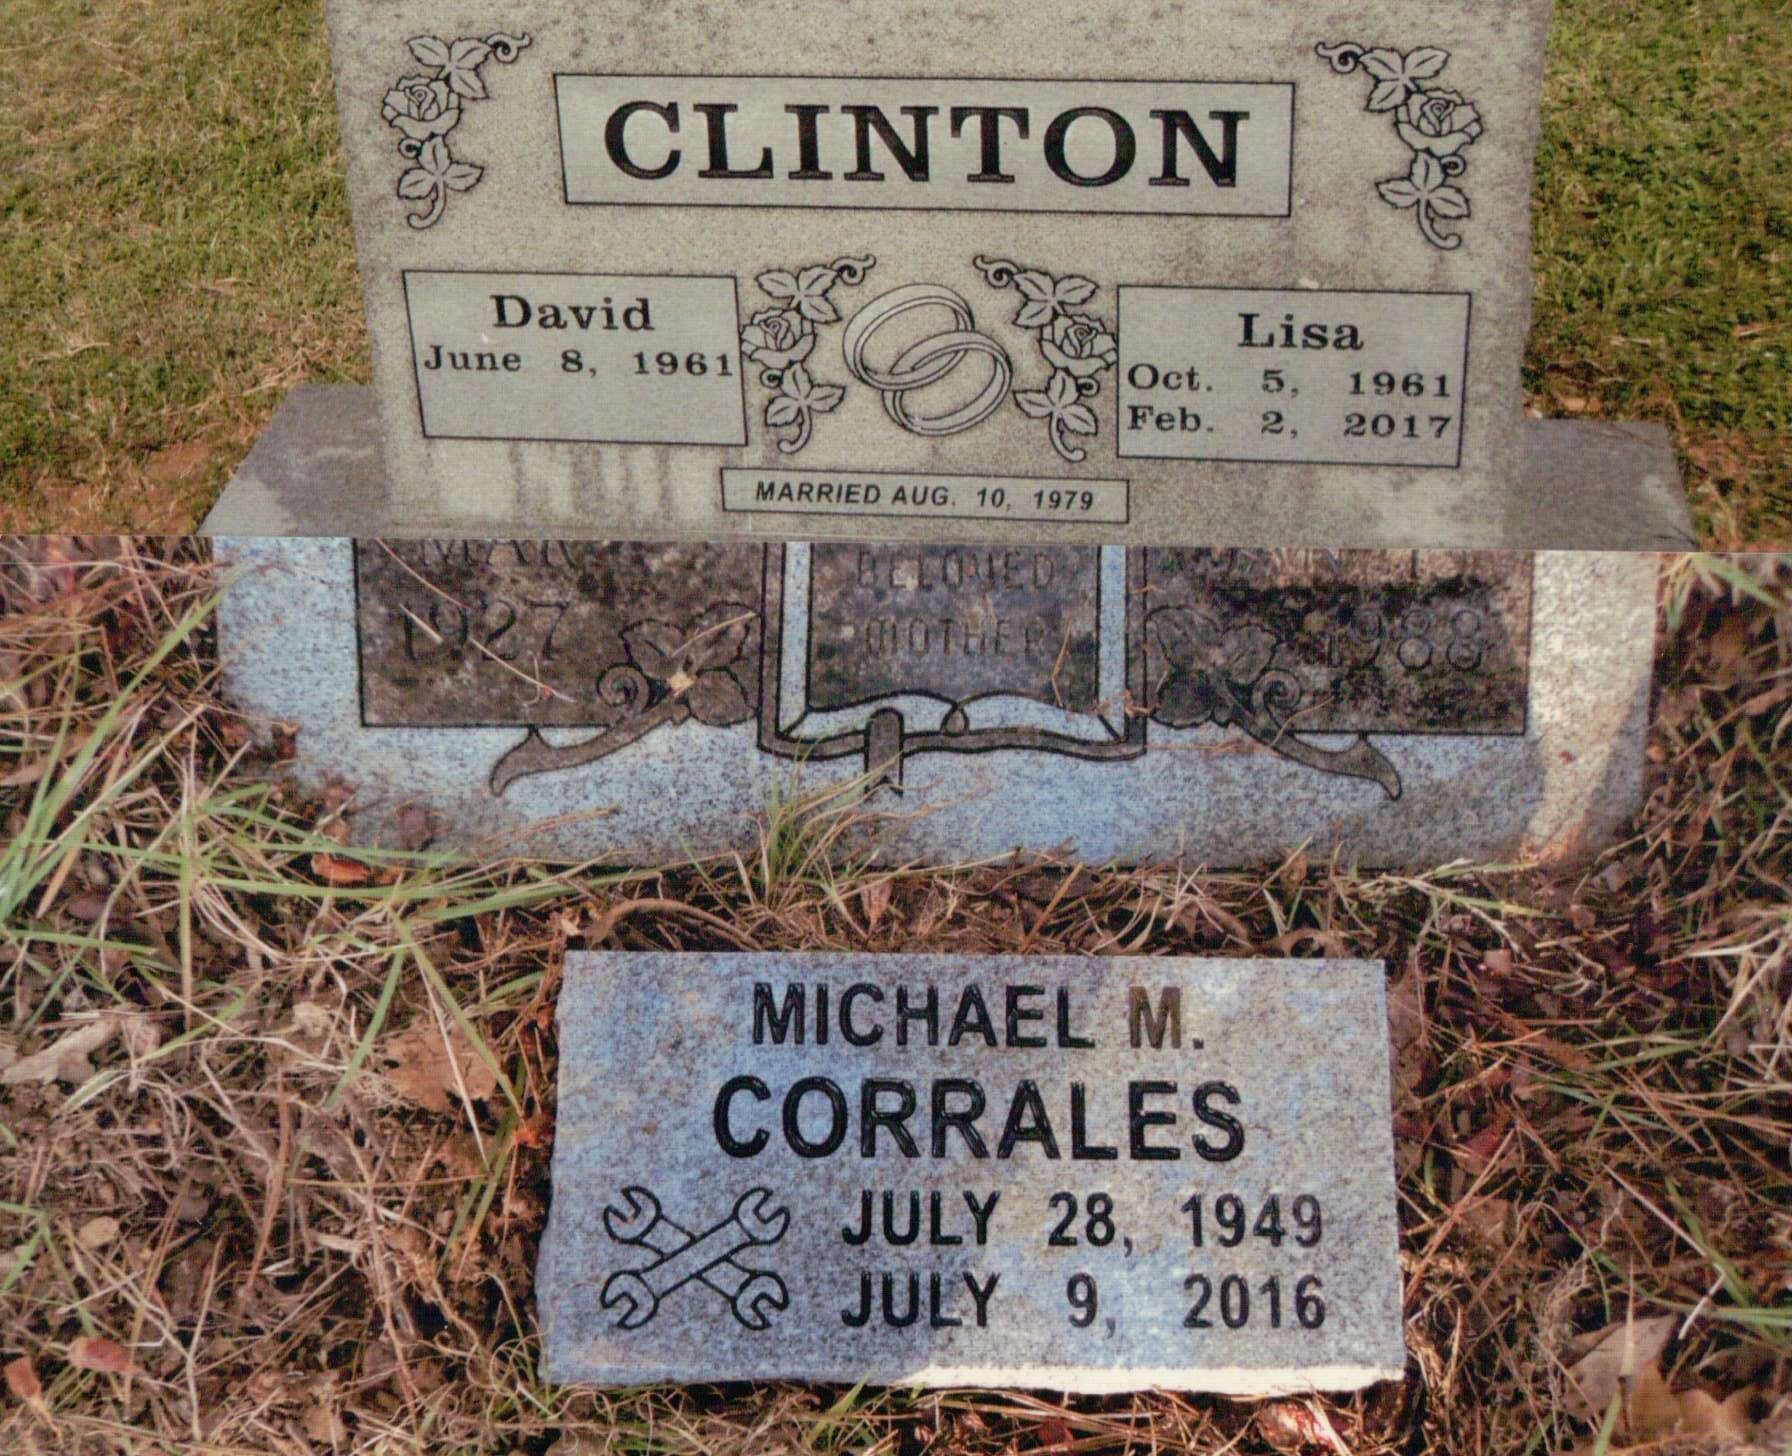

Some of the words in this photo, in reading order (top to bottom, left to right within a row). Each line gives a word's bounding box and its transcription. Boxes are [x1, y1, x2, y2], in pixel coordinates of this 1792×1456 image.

[603, 101, 1250, 188] CLINTON
[495, 295, 654, 330] David
[1237, 313, 1364, 351] Lisa
[425, 345, 521, 372] June
[561, 349, 597, 376] 8,
[634, 351, 734, 377] 1961
[1127, 363, 1213, 392] Oct.
[1262, 369, 1299, 397] 5,
[1350, 372, 1450, 397] 1961
[1127, 405, 1214, 433] Feb.
[1262, 411, 1298, 439] 2,
[1343, 414, 1451, 438] 2017
[756, 480, 884, 508] MARRIED
[891, 484, 955, 507] AUG.
[976, 488, 1013, 512] 10,
[1034, 490, 1094, 512] 1979
[752, 983, 1095, 1049] MICHAEL
[1128, 986, 1205, 1049] M.
[713, 1075, 1245, 1162] CORRALES
[841, 1190, 1000, 1247] JULY
[1047, 1192, 1133, 1259] 28,
[1181, 1194, 1324, 1247] 1949
[841, 1273, 1000, 1328] JULY
[1066, 1274, 1117, 1336] 9,
[1182, 1275, 1327, 1329] 2016
